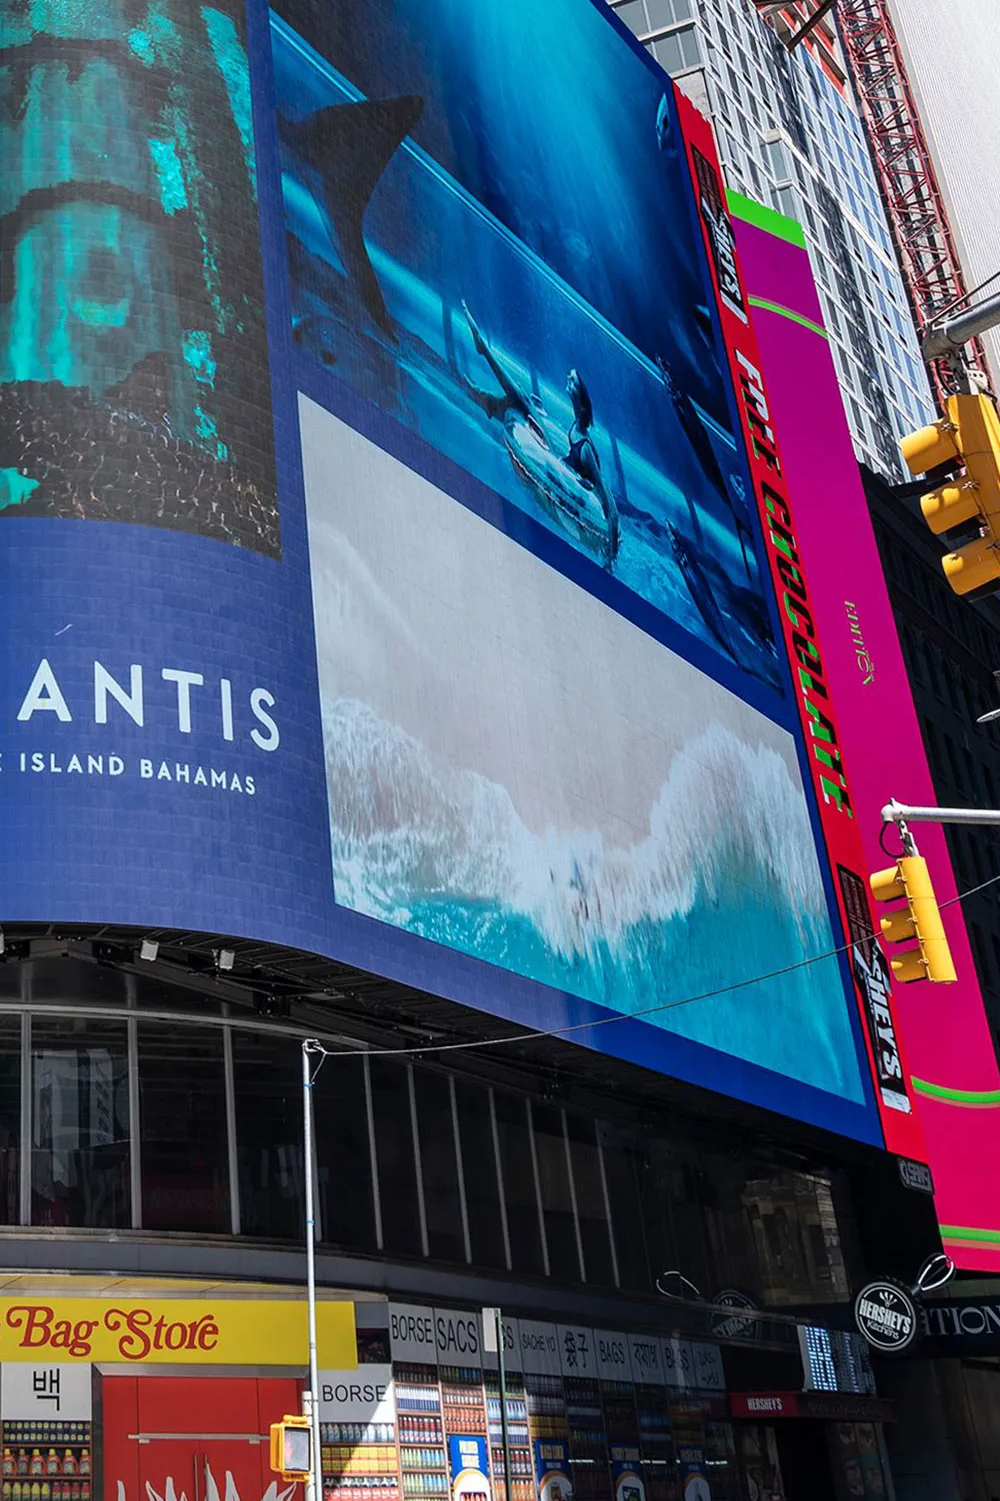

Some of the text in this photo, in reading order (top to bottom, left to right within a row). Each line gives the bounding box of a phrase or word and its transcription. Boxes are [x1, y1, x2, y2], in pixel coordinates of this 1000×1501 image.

[735, 348, 854, 819] FREE CHOCOLATE
[20, 752, 125, 776] ISLAND
[141, 759, 256, 795] BAHAMAS
[5, 1305, 99, 1358] Bag
[104, 1308, 219, 1360] Store
[391, 1314, 433, 1343] BORSE
[859, 1298, 912, 1335] HERSHEY'S
[866, 1318, 900, 1341] Kitchens
[437, 1318, 478, 1353] SACS
[564, 1331, 589, 1368] 袋子
[600, 1340, 625, 1365] BAGS
[33, 1367, 60, 1412] 백
[322, 1384, 387, 1402] BORSE
[747, 1397, 782, 1411] HERSHEY'S
